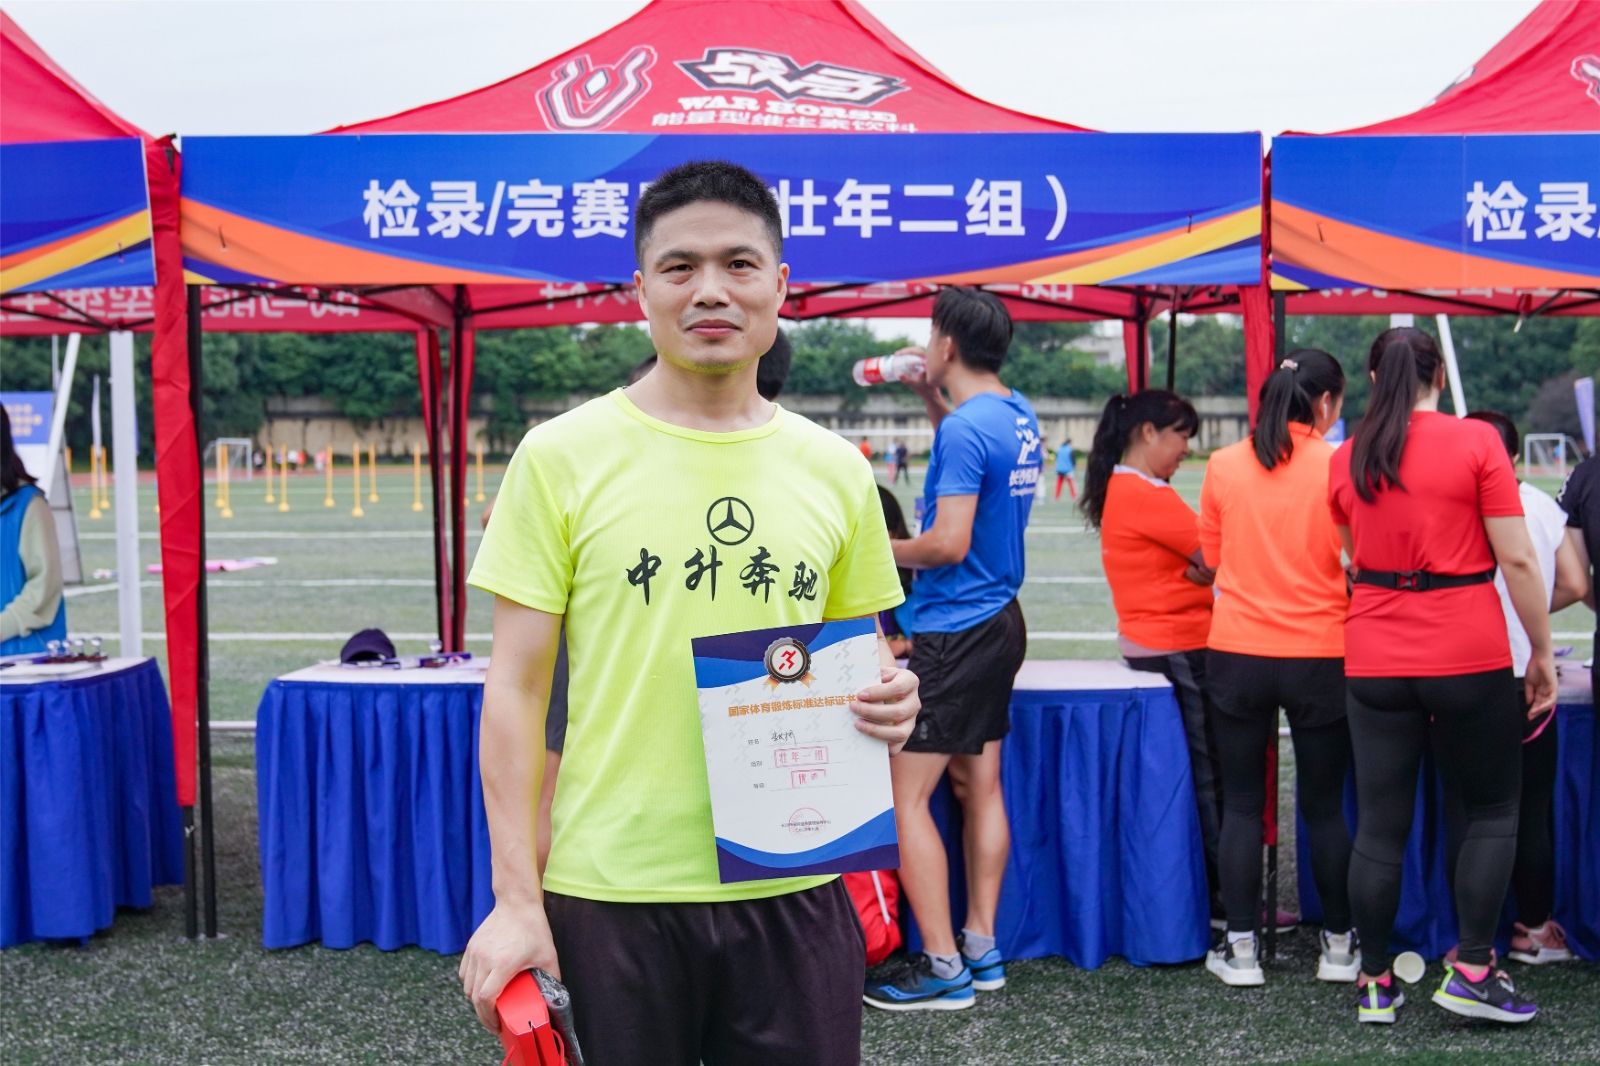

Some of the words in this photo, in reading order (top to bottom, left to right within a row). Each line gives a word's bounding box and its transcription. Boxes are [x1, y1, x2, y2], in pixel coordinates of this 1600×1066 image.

[651, 110, 918, 134] 能量型维生素饮料
[677, 96, 760, 111] WAR
[363, 174, 1069, 242] 检录/完赛壮年二组）
[1466, 181, 1600, 242] 检录
[626, 545, 818, 606] 中升奔驰
